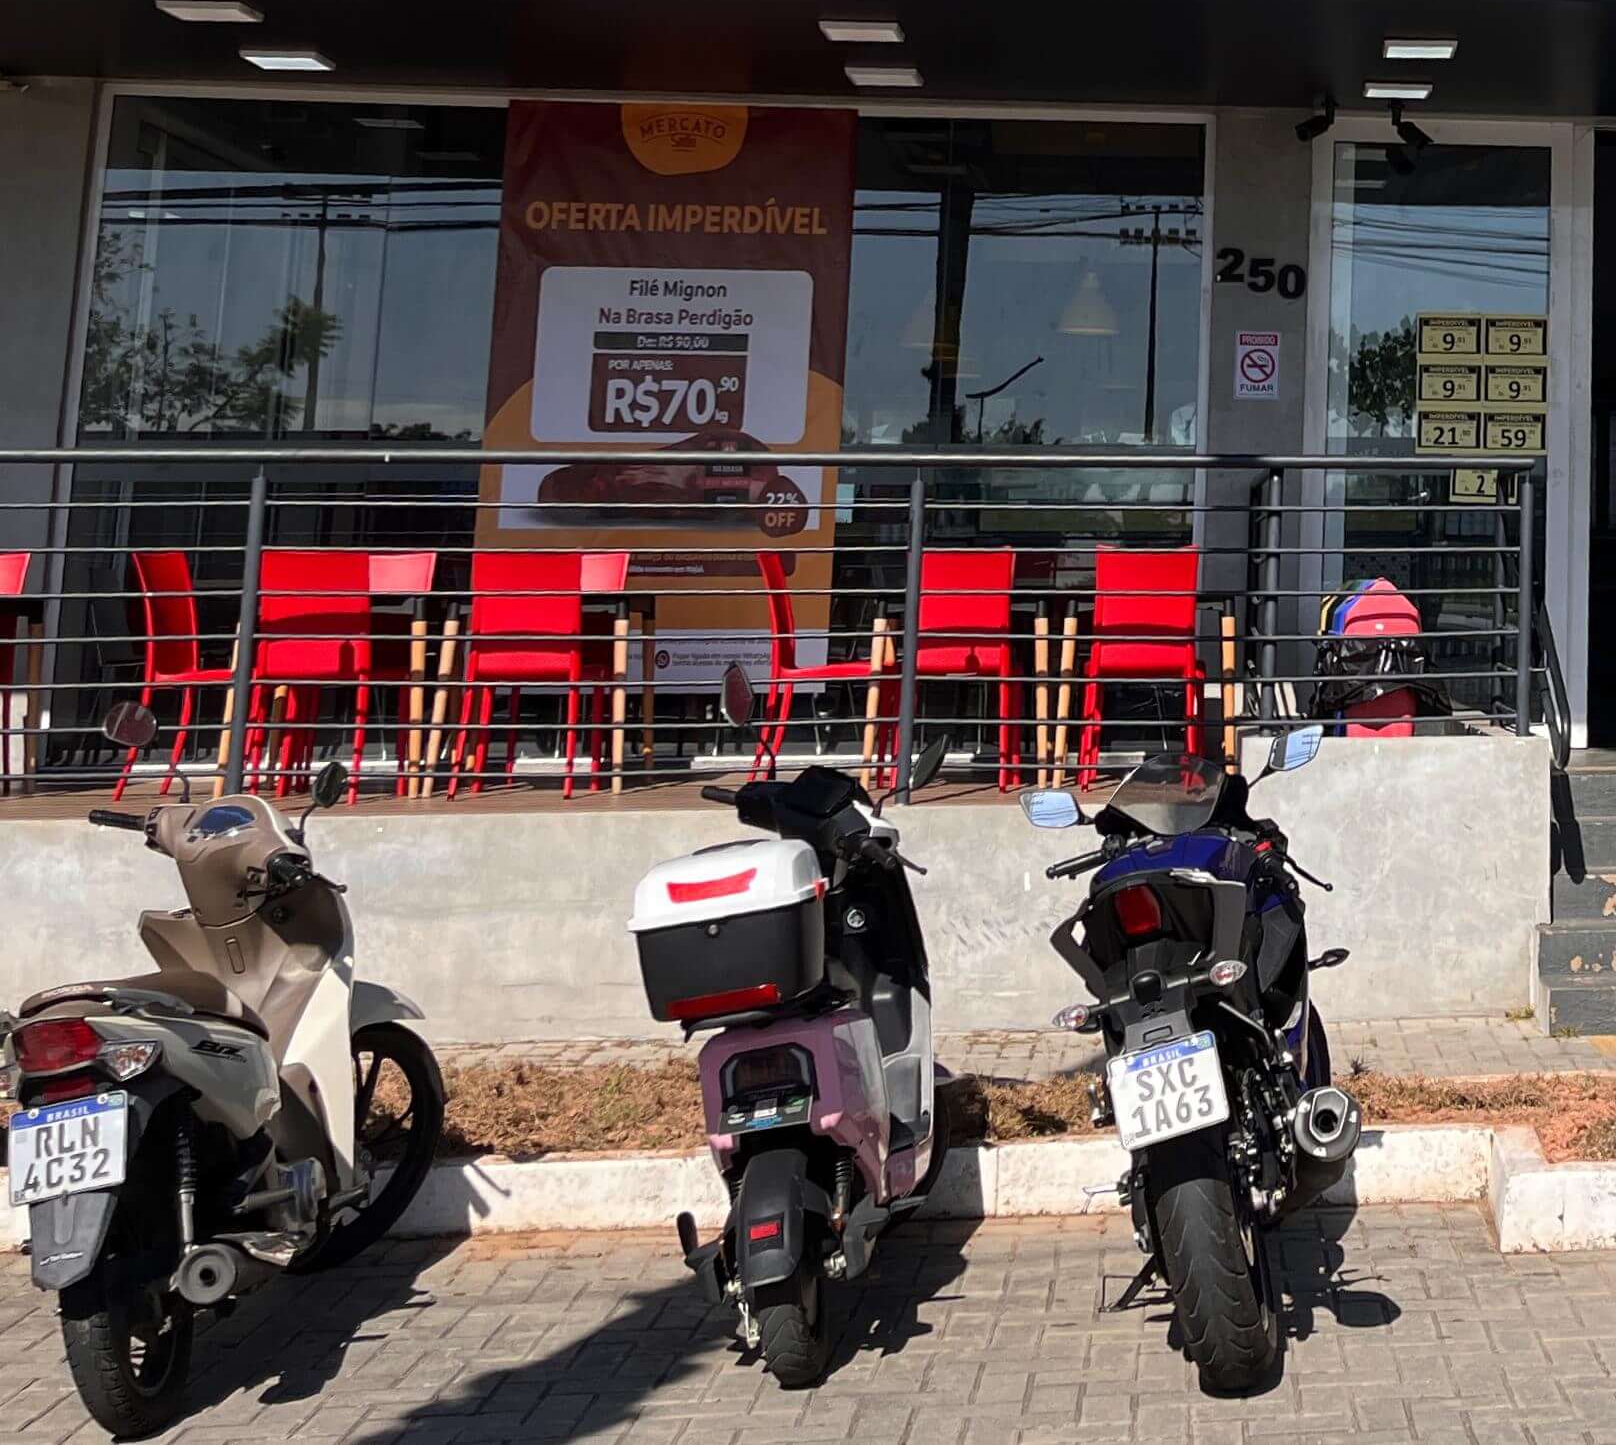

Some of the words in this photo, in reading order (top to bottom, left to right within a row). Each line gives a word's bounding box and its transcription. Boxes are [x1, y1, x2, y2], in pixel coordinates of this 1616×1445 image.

[640, 117, 726, 139] MERCATO
[526, 201, 641, 231] OFERTA
[648, 198, 827, 235] IMPERDÍVEL
[1215, 247, 1307, 299] 250
[629, 279, 659, 297] Filé
[663, 280, 727, 301] Mignon
[598, 308, 622, 324] Na
[626, 308, 674, 325] Brasa
[678, 309, 754, 330] Perdigão
[1442, 333, 1455, 351] 9
[1508, 334, 1521, 352] 9
[608, 360, 629, 371] POR
[1240, 383, 1274, 393] FUMAR
[1442, 380, 1455, 398] 9
[1508, 381, 1521, 399] 9
[605, 375, 716, 427] R$70
[1433, 426, 1459, 445] 21
[1501, 429, 1526, 448] 59
[764, 512, 796, 528] OFF
[1142, 1048, 1180, 1067] BRASIL
[1136, 1057, 1198, 1102] SXC
[46, 1105, 90, 1123] BRASIL
[1131, 1084, 1214, 1138] 1A63
[35, 1116, 99, 1159] RLN
[23, 1148, 111, 1193] 4C32
